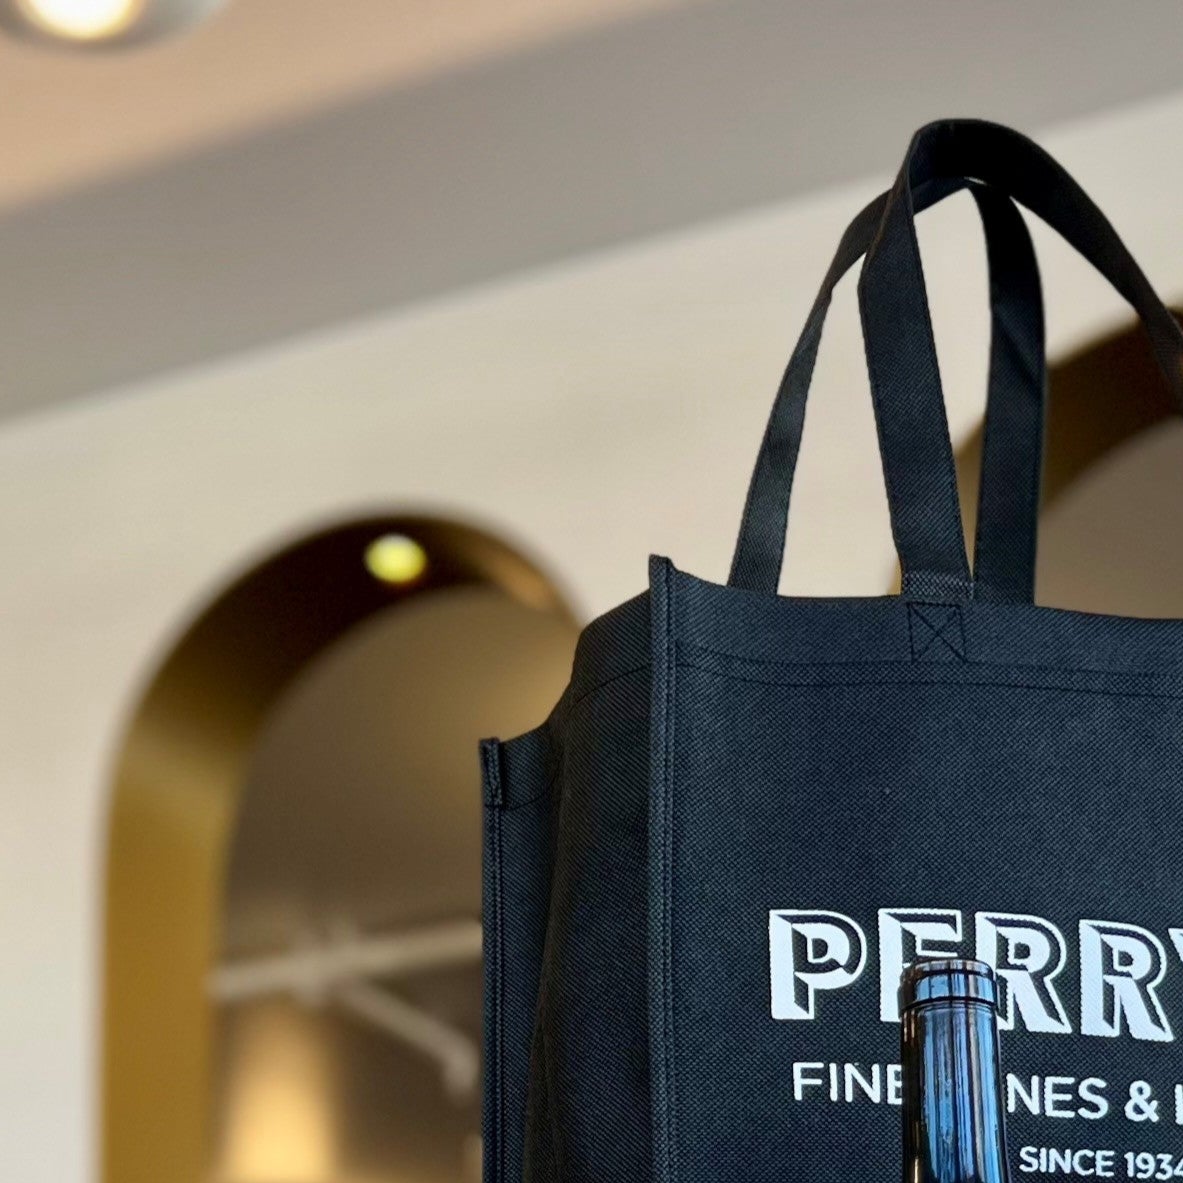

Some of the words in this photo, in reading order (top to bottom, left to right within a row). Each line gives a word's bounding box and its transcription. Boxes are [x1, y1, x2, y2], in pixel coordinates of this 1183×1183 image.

[1005, 1072, 1109, 1120] NES
[1123, 1080, 1160, 1123] &
[1018, 1145, 1115, 1177] SINCE
